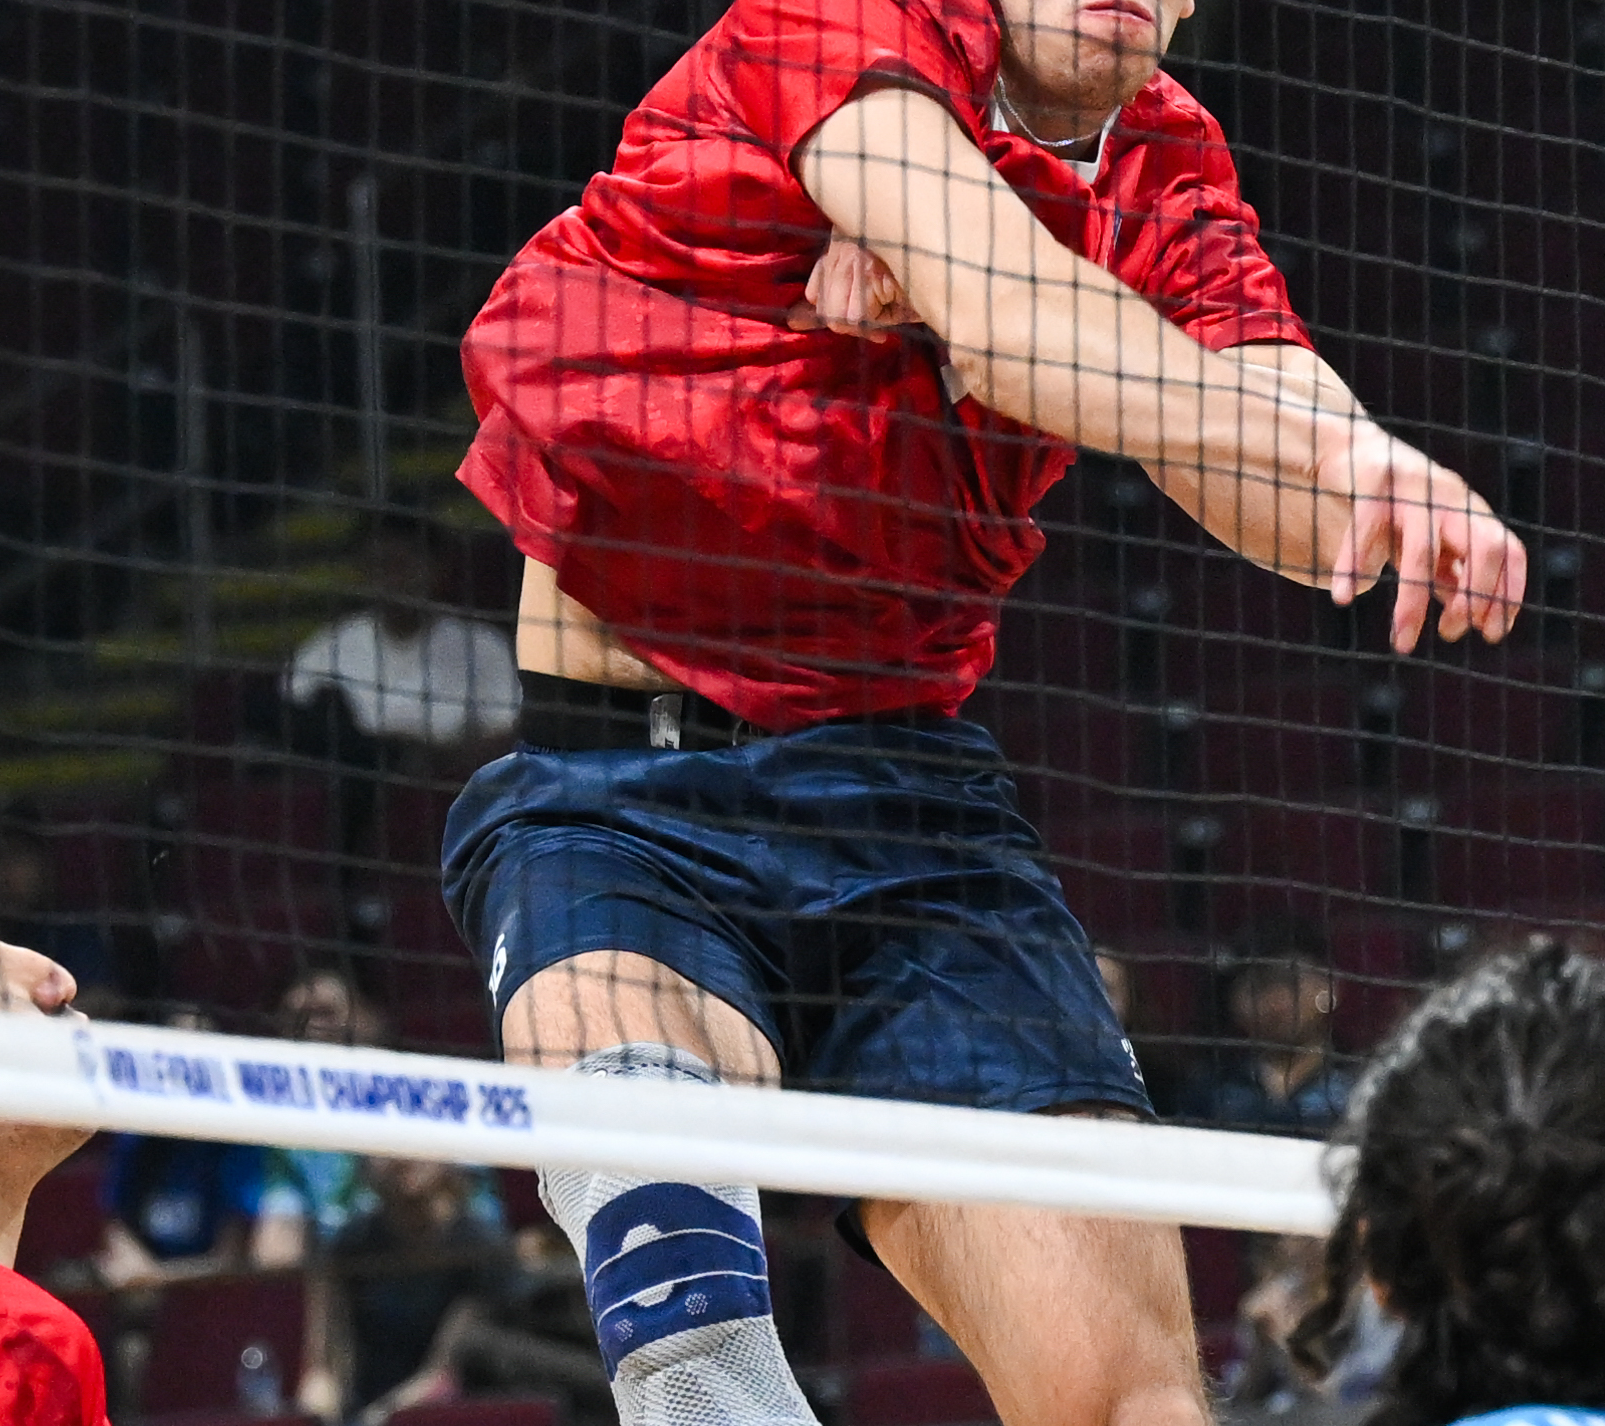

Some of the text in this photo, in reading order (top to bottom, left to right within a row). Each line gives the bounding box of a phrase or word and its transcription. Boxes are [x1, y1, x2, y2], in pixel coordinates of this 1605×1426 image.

[103, 1046, 234, 1103] VOLLEYBALL
[236, 1059, 316, 1111] WORLD
[319, 1067, 470, 1126] CHAMPIONSHIP
